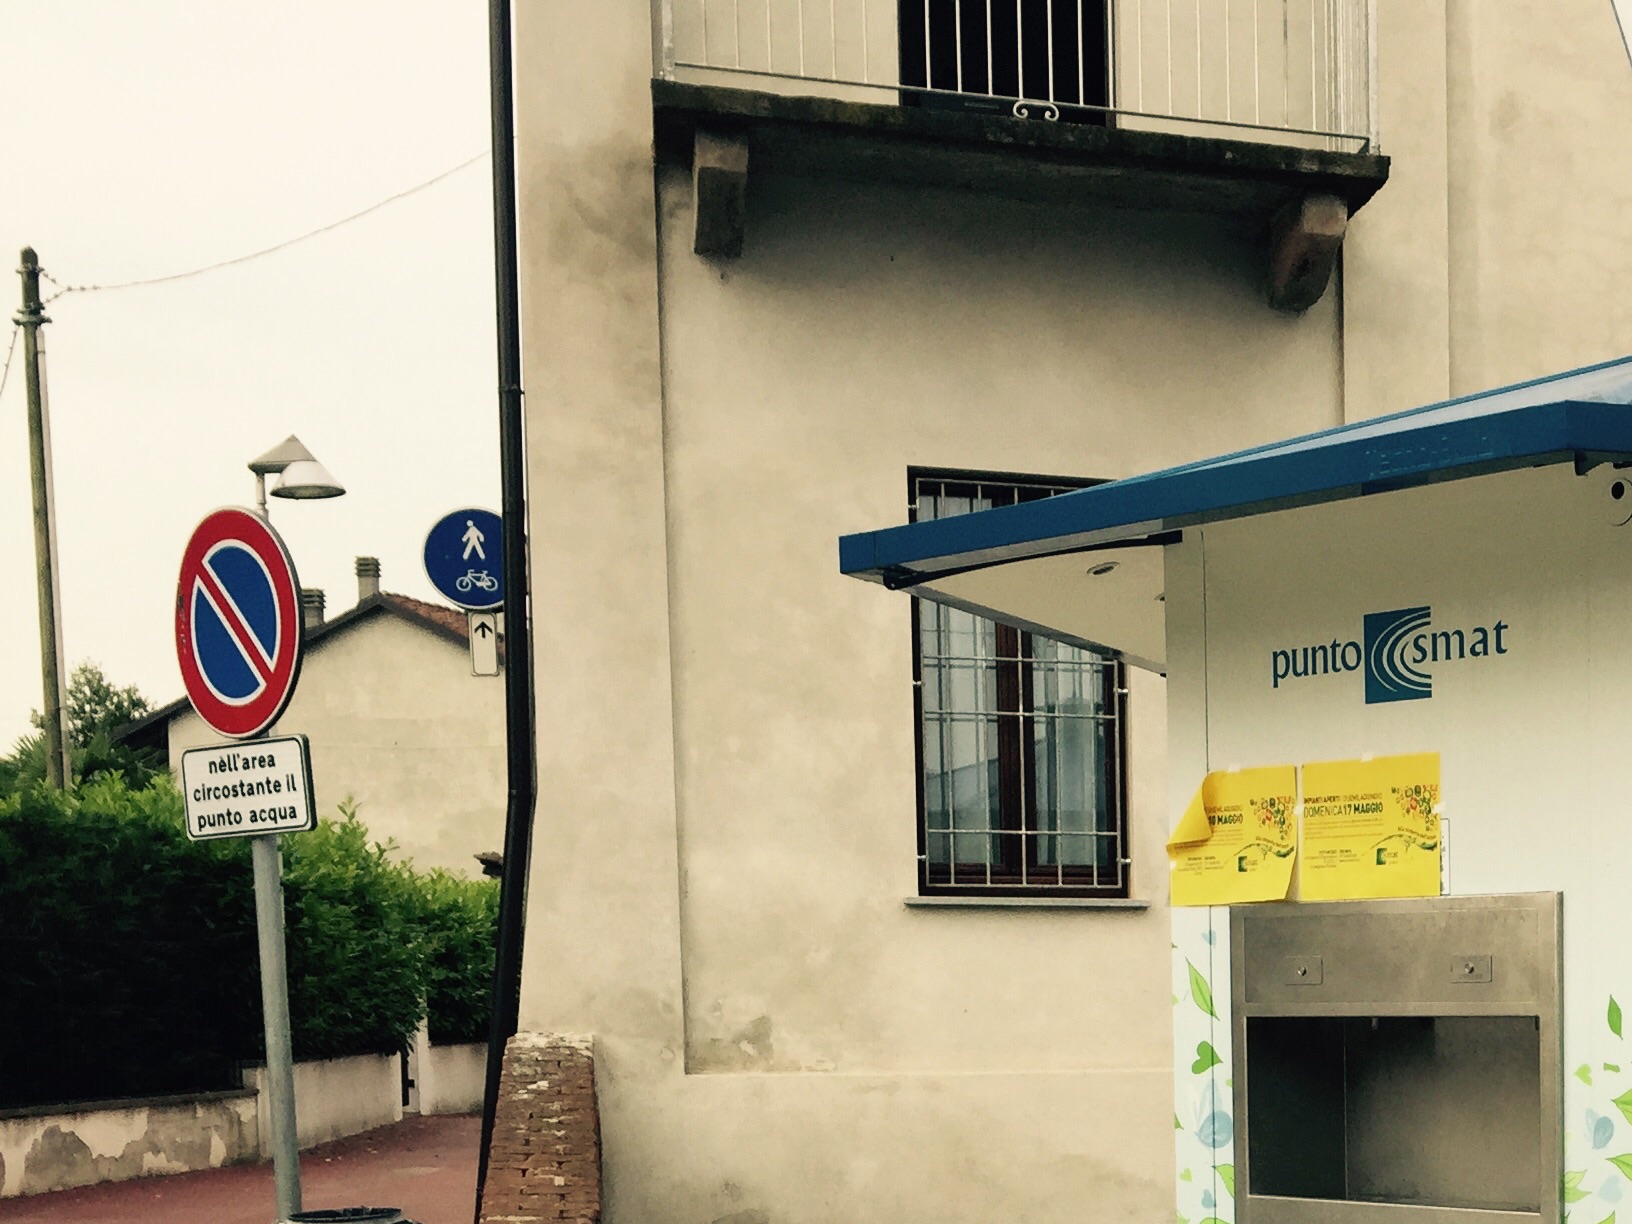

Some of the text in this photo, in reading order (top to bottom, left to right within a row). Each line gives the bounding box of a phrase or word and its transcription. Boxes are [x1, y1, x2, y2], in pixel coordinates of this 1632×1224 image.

[1271, 620, 1508, 689] punto smat
[193, 773, 297, 802] circostante il
[197, 805, 297, 832] punto acqua
[1217, 813, 1244, 825] MAGGIO
[1303, 801, 1384, 818] DOMENICA 17 MAGGIO
